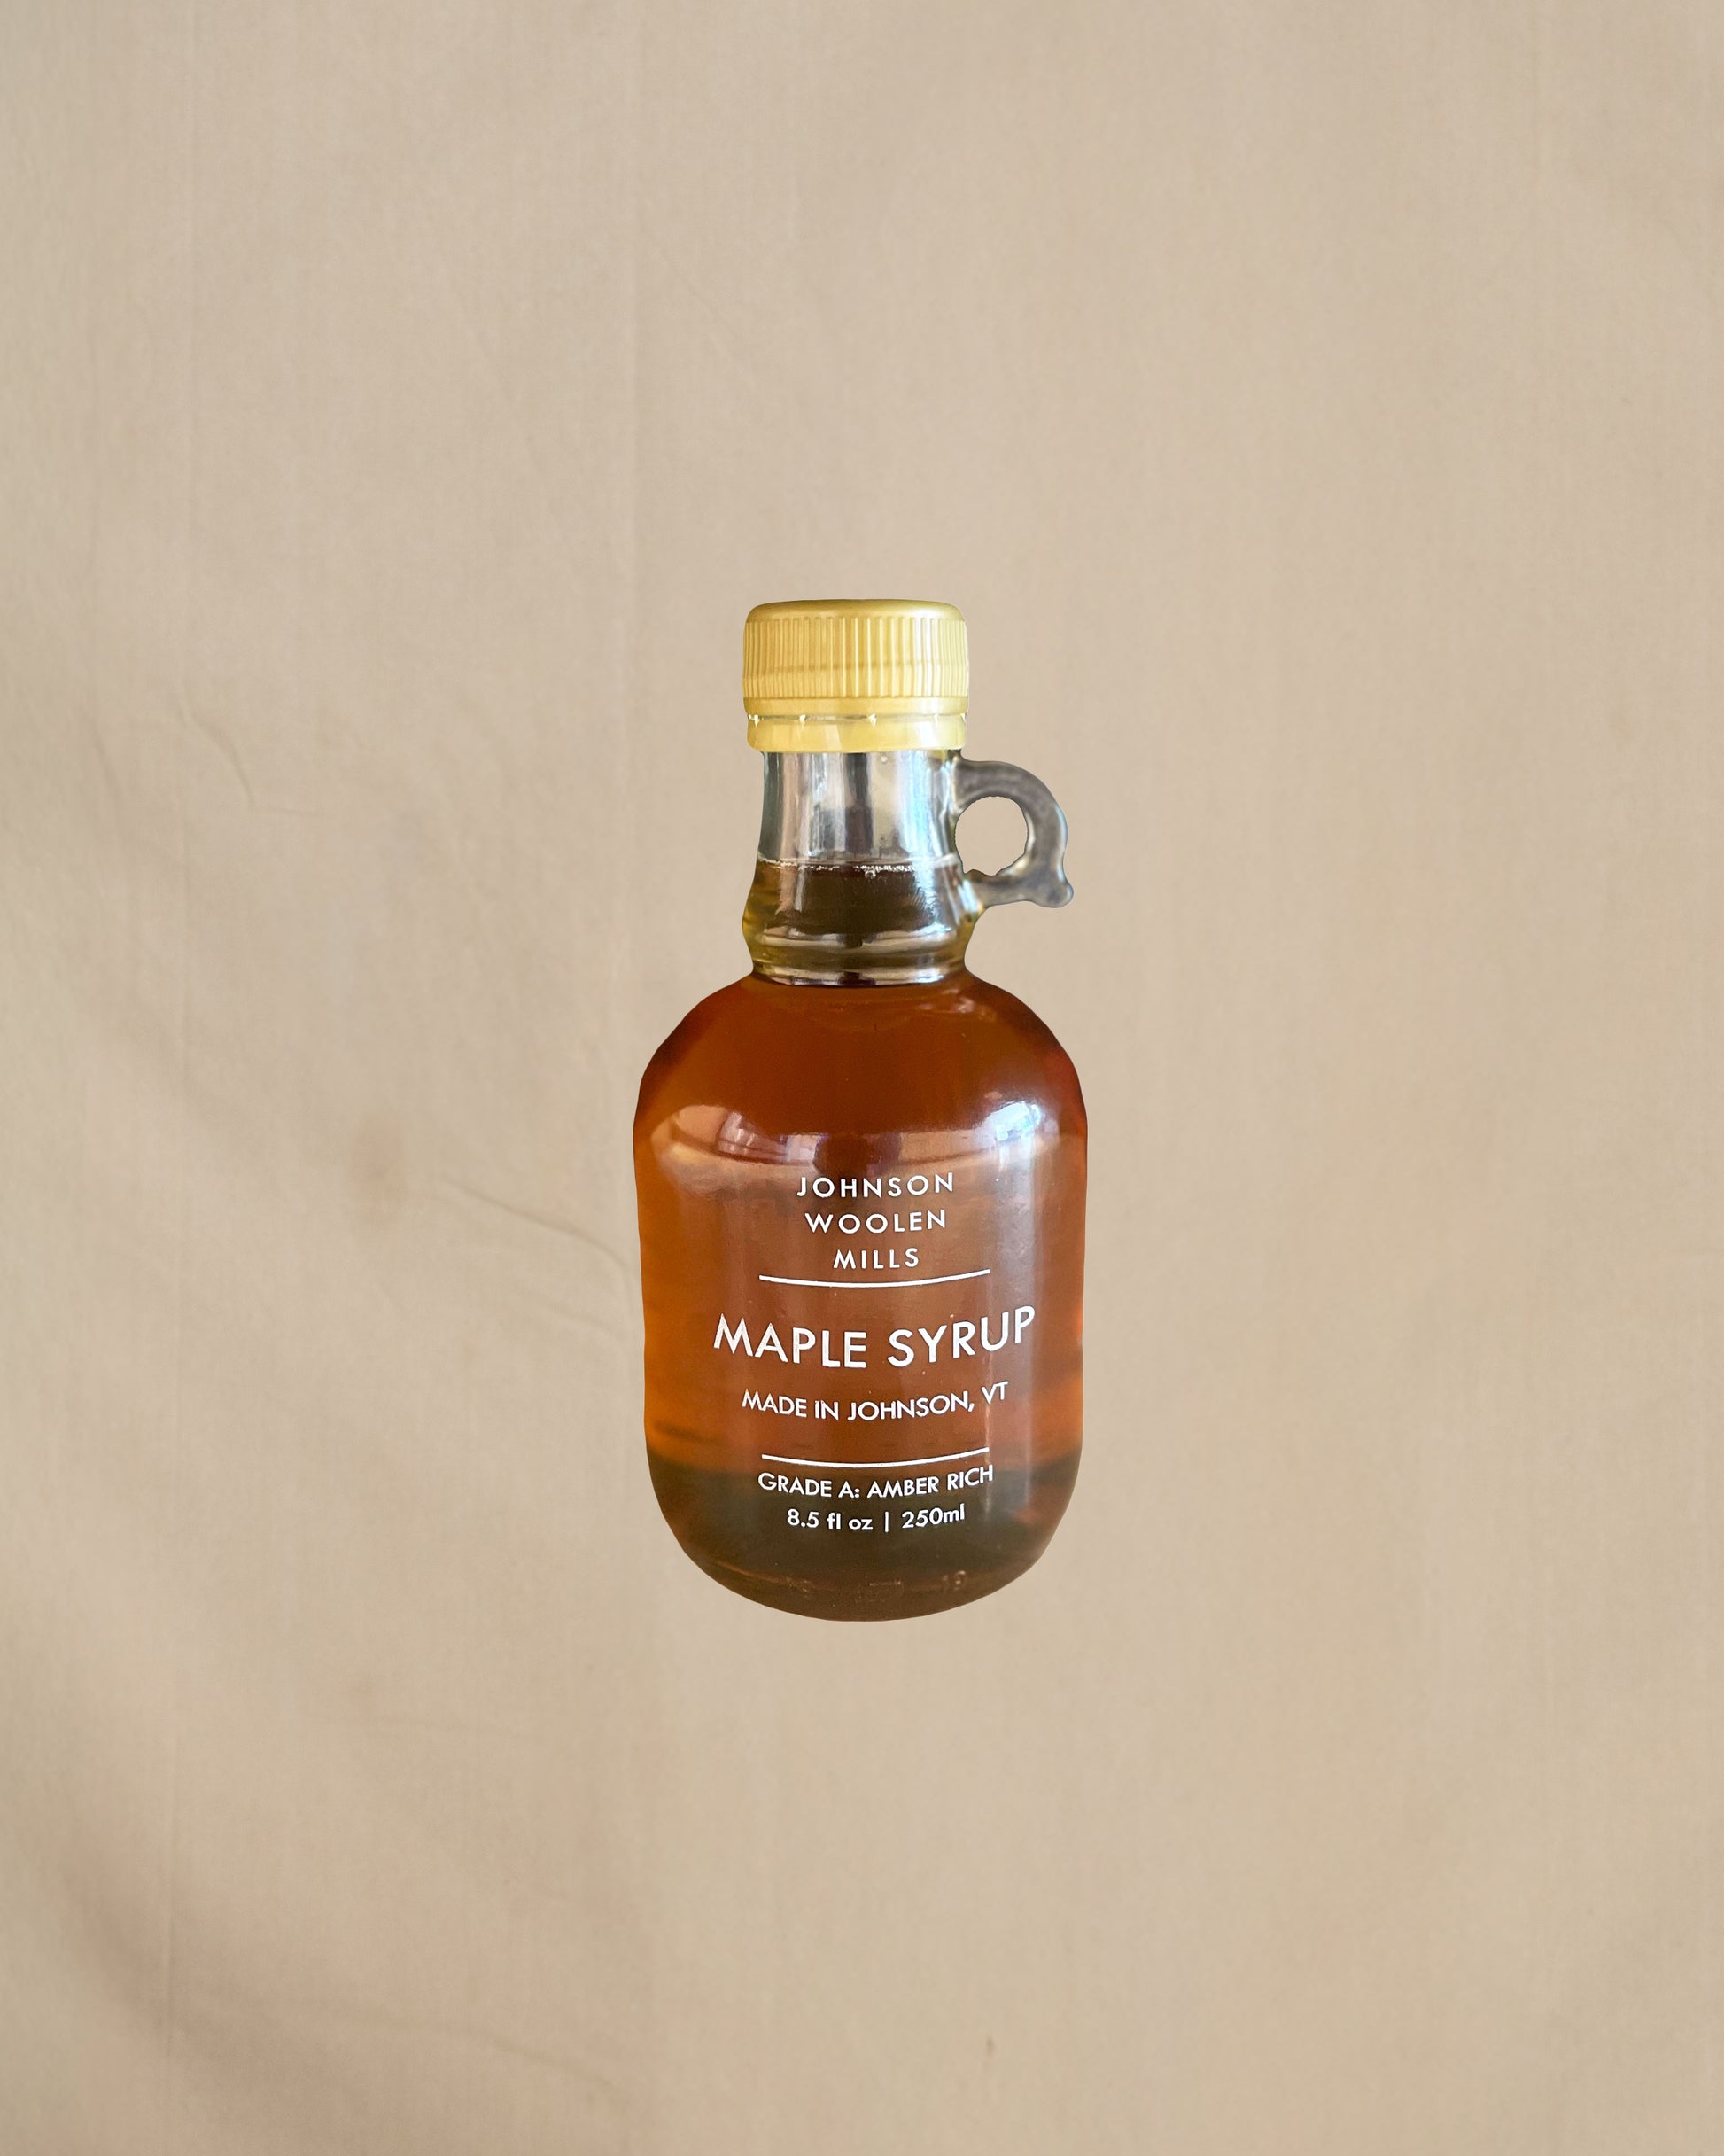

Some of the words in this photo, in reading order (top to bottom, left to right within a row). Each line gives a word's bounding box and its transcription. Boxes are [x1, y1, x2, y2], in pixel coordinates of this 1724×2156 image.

[796, 1171, 954, 1199] JOHNSON
[804, 1209, 946, 1234] WOOLEN
[833, 1247, 919, 1270] MILLS
[713, 1312, 867, 1369] MAPLE
[887, 1305, 1036, 1367] SYRUP
[742, 1389, 808, 1418] MADE
[814, 1399, 839, 1421] IN
[847, 1390, 975, 1421] JOHNSON,
[981, 1381, 1009, 1405] VT
[757, 1472, 833, 1498] GRADE
[837, 1480, 860, 1499] A:
[866, 1475, 940, 1499] AMBER
[947, 1464, 994, 1491] RICH
[787, 1508, 819, 1529] 8.5
[826, 1512, 842, 1530] fl
[848, 1518, 874, 1531] oz
[901, 1502, 966, 1529] 250ml
